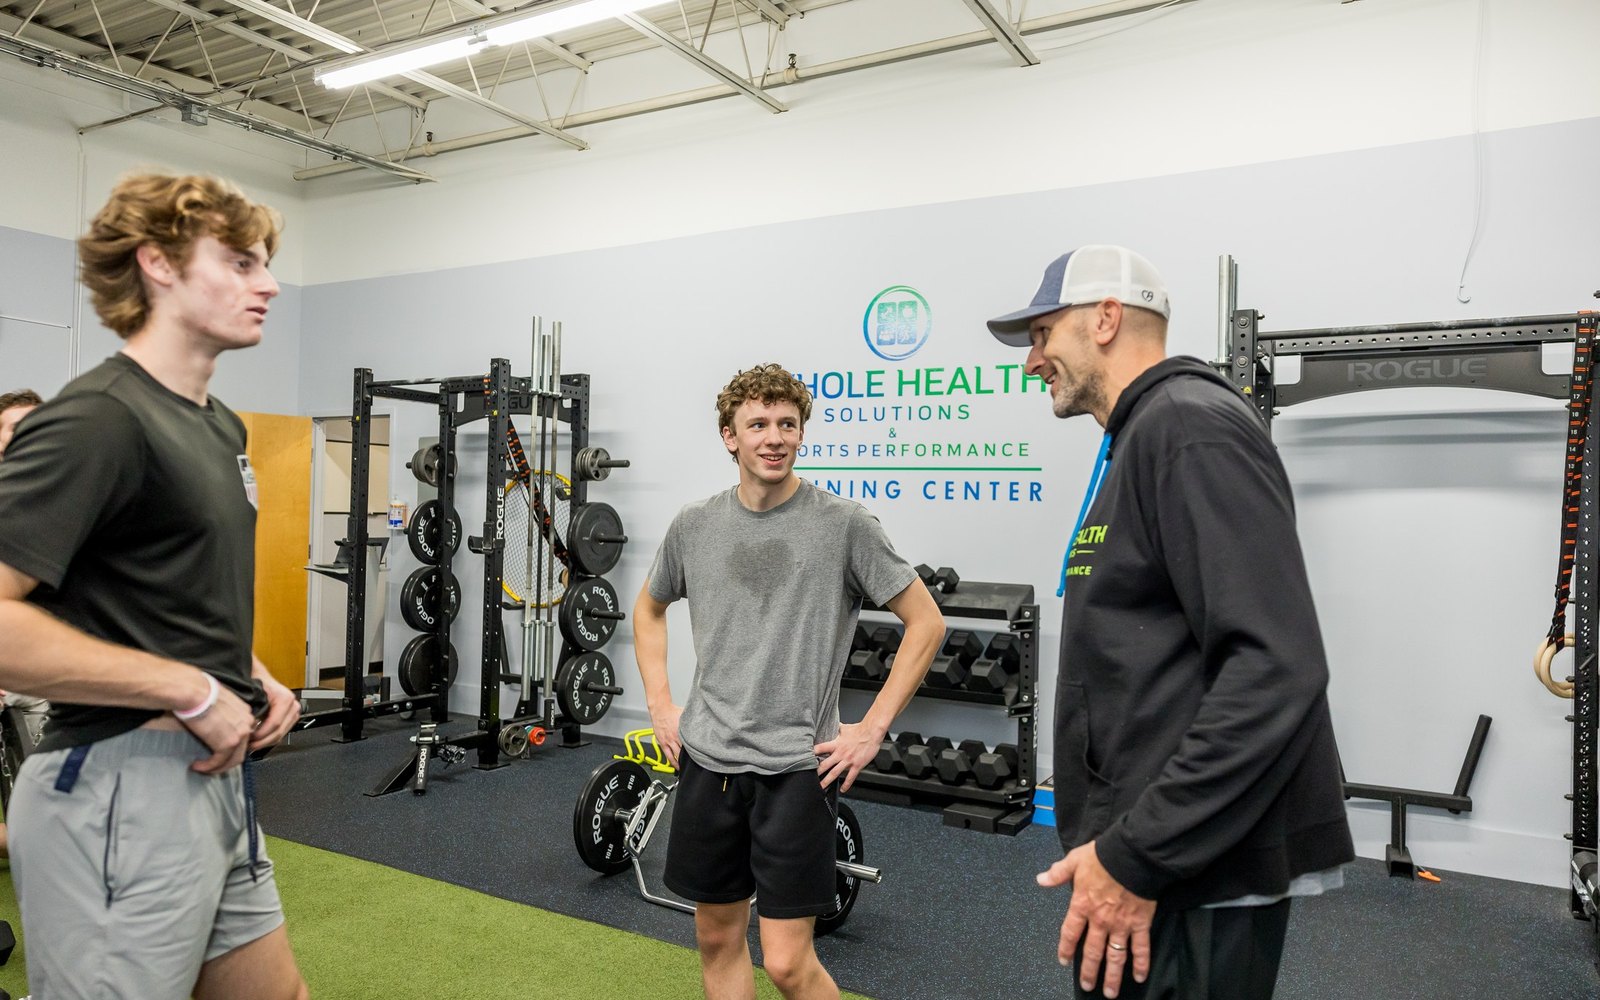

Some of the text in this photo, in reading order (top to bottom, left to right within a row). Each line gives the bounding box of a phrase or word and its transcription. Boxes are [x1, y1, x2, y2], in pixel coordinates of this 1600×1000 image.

[791, 364, 1047, 399] HOLE HEALTH
[1348, 357, 1488, 382] ROGUE
[824, 404, 970, 423] SOLUTIONS
[888, 427, 898, 439] &
[797, 442, 1030, 458] ORTS PERFORMANCE
[814, 480, 1043, 501] NING CENTER
[497, 486, 505, 540] ROGUE
[418, 516, 435, 557] ROGUE
[415, 596, 435, 625] OGUE
[592, 586, 614, 613] ROGU
[576, 608, 599, 642] ROGUE
[572, 662, 589, 710] ROGUE
[595, 667, 611, 714] ROUE
[592, 774, 619, 845] ROGUE
